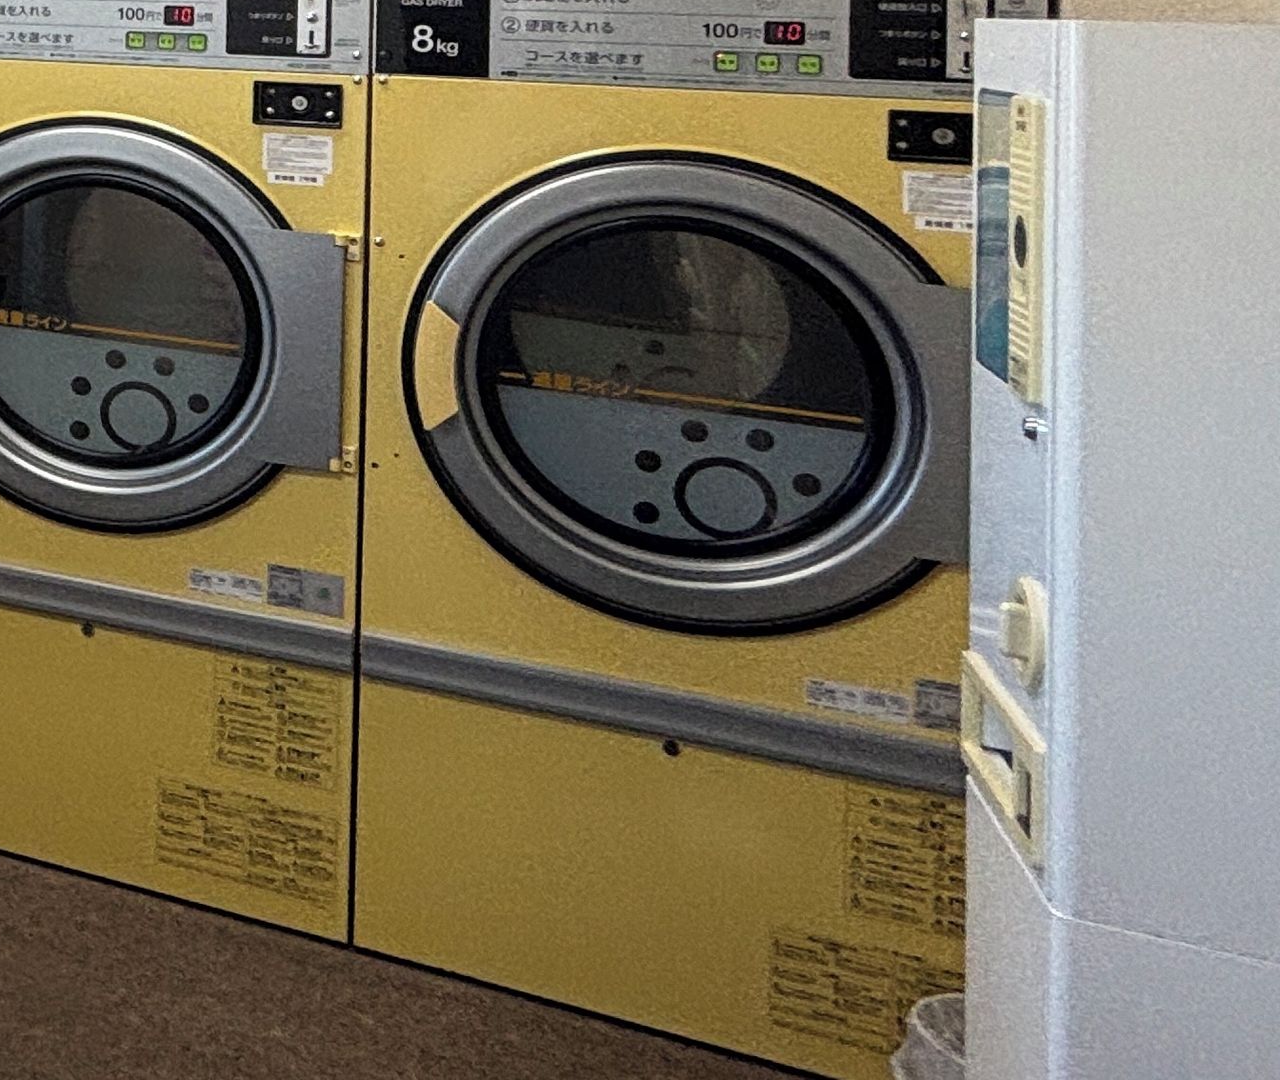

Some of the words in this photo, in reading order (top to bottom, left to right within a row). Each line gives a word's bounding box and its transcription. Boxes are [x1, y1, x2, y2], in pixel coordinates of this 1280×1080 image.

[525, 50, 645, 67] コースを選べます
